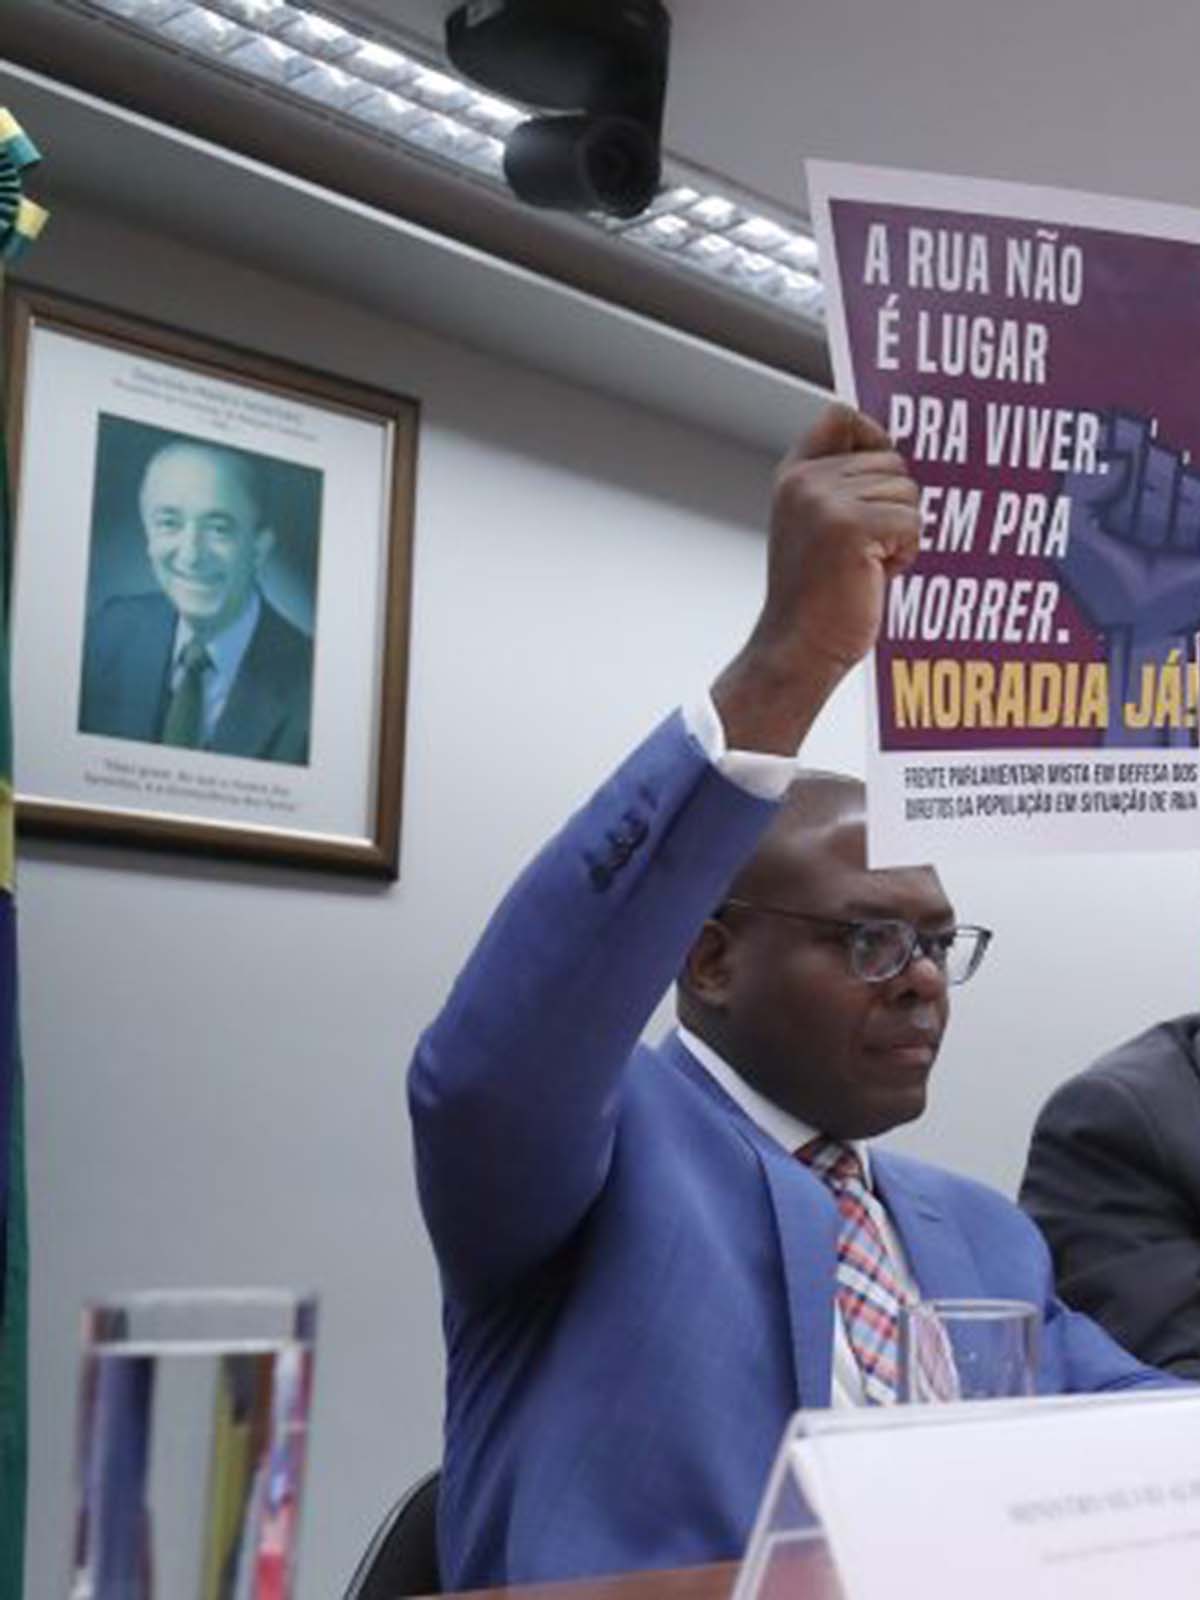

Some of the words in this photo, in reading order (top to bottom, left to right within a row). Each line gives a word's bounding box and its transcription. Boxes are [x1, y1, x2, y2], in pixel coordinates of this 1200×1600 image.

[863, 224, 890, 286] A
[908, 227, 989, 294] RUA
[1006, 228, 1083, 305] NÃO
[877, 294, 900, 370] É
[917, 310, 1048, 385] LUGAR
[889, 394, 967, 466] PRA
[986, 403, 1109, 475] VIVER.
[918, 486, 982, 553] EM
[988, 492, 1073, 559] PRA
[887, 574, 1070, 645] MORRER.
[891, 658, 1109, 731] MORADIA
[1123, 649, 1198, 729] JÁ!
[949, 763, 1045, 786] PARLAMENTAR
[1118, 763, 1169, 784] DEFESA
[1172, 763, 1198, 783] DOS
